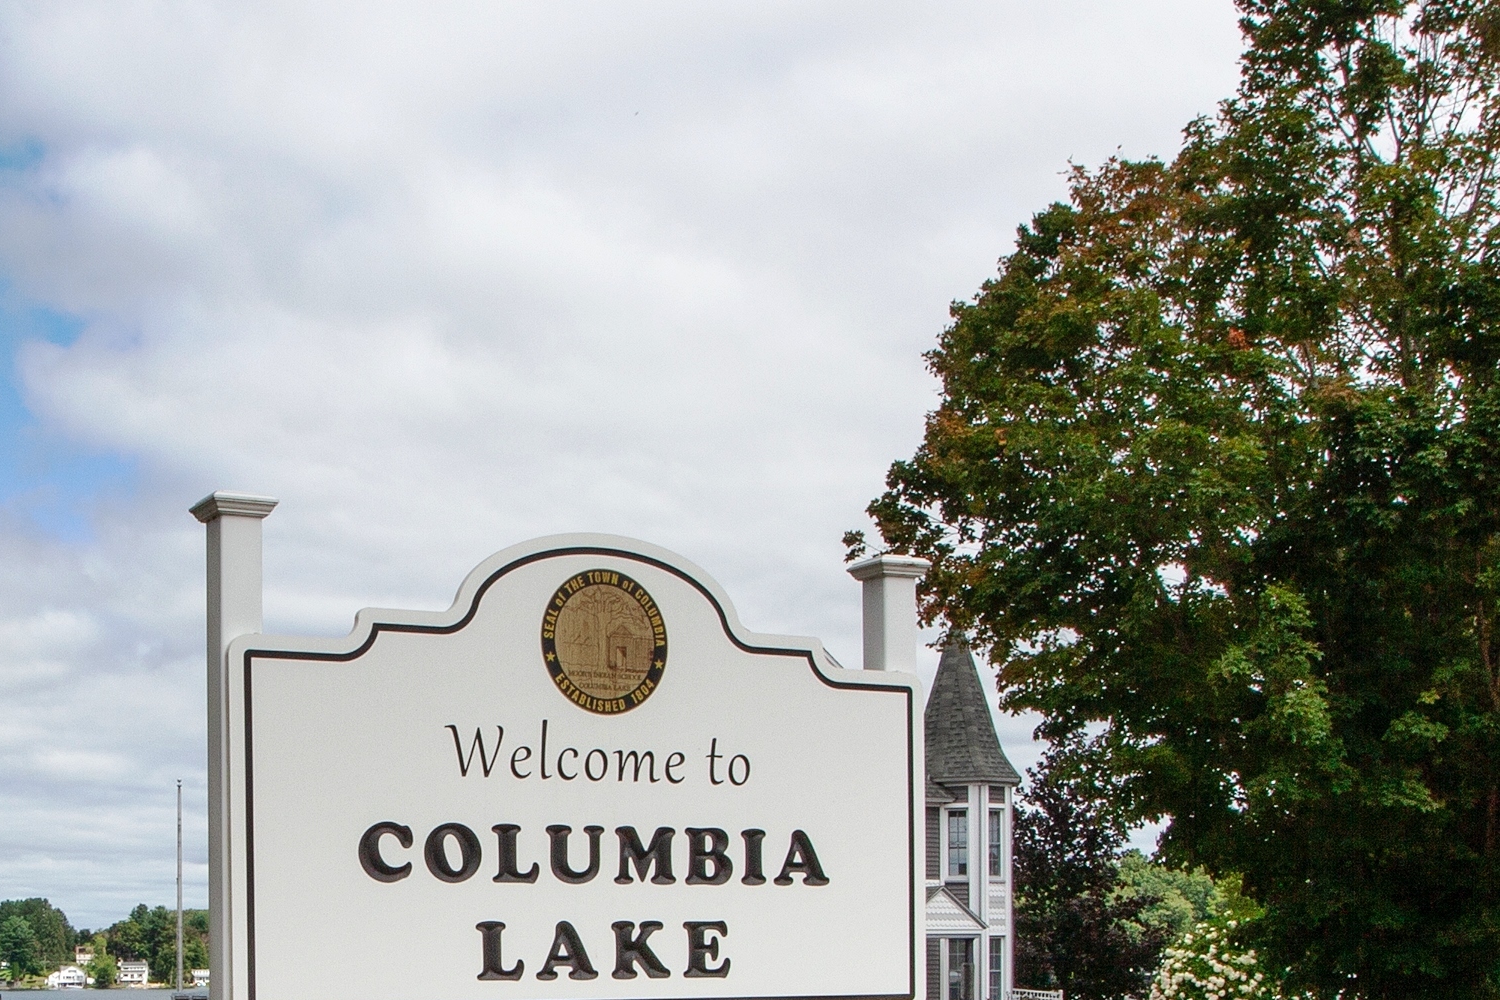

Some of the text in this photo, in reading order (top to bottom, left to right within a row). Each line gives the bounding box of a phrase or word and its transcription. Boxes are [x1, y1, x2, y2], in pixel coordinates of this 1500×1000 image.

[543, 571, 666, 647] SEAL of THE TOWN of COLUMBIA
[555, 673, 655, 712] ESTABLISHED 1804
[444, 719, 751, 786] Welcome to
[358, 821, 830, 887] COLUMBIA
[475, 920, 731, 982] LAKE
